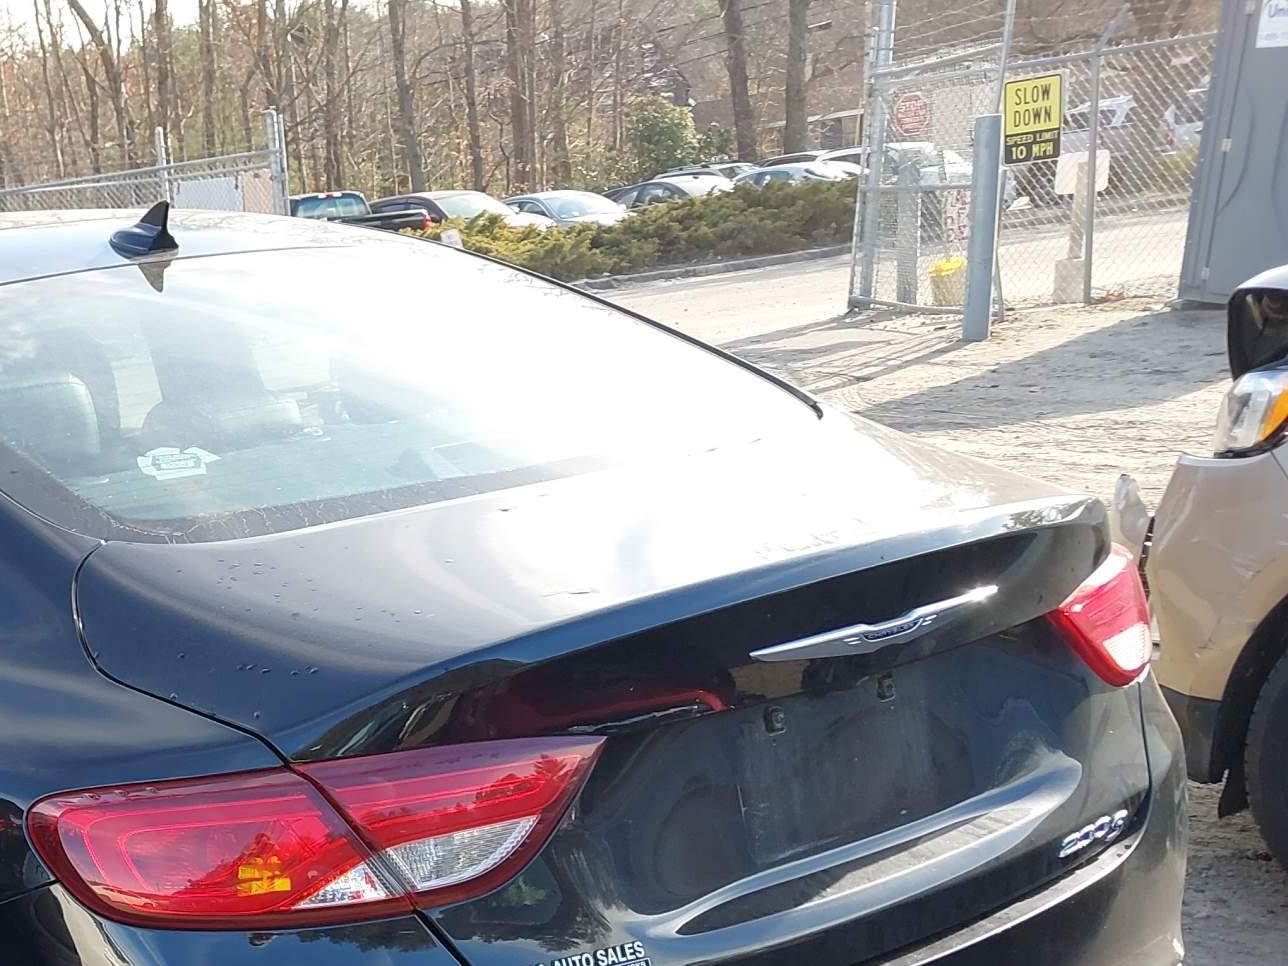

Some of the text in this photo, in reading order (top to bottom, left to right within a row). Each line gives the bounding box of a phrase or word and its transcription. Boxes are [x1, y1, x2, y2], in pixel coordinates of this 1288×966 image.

[1015, 83, 1051, 106] SLOW
[1014, 106, 1052, 128] DOWN
[1006, 130, 1059, 145] SPEED LIMIT
[1011, 141, 1054, 160] 10 MPH
[598, 940, 645, 966] SALES
